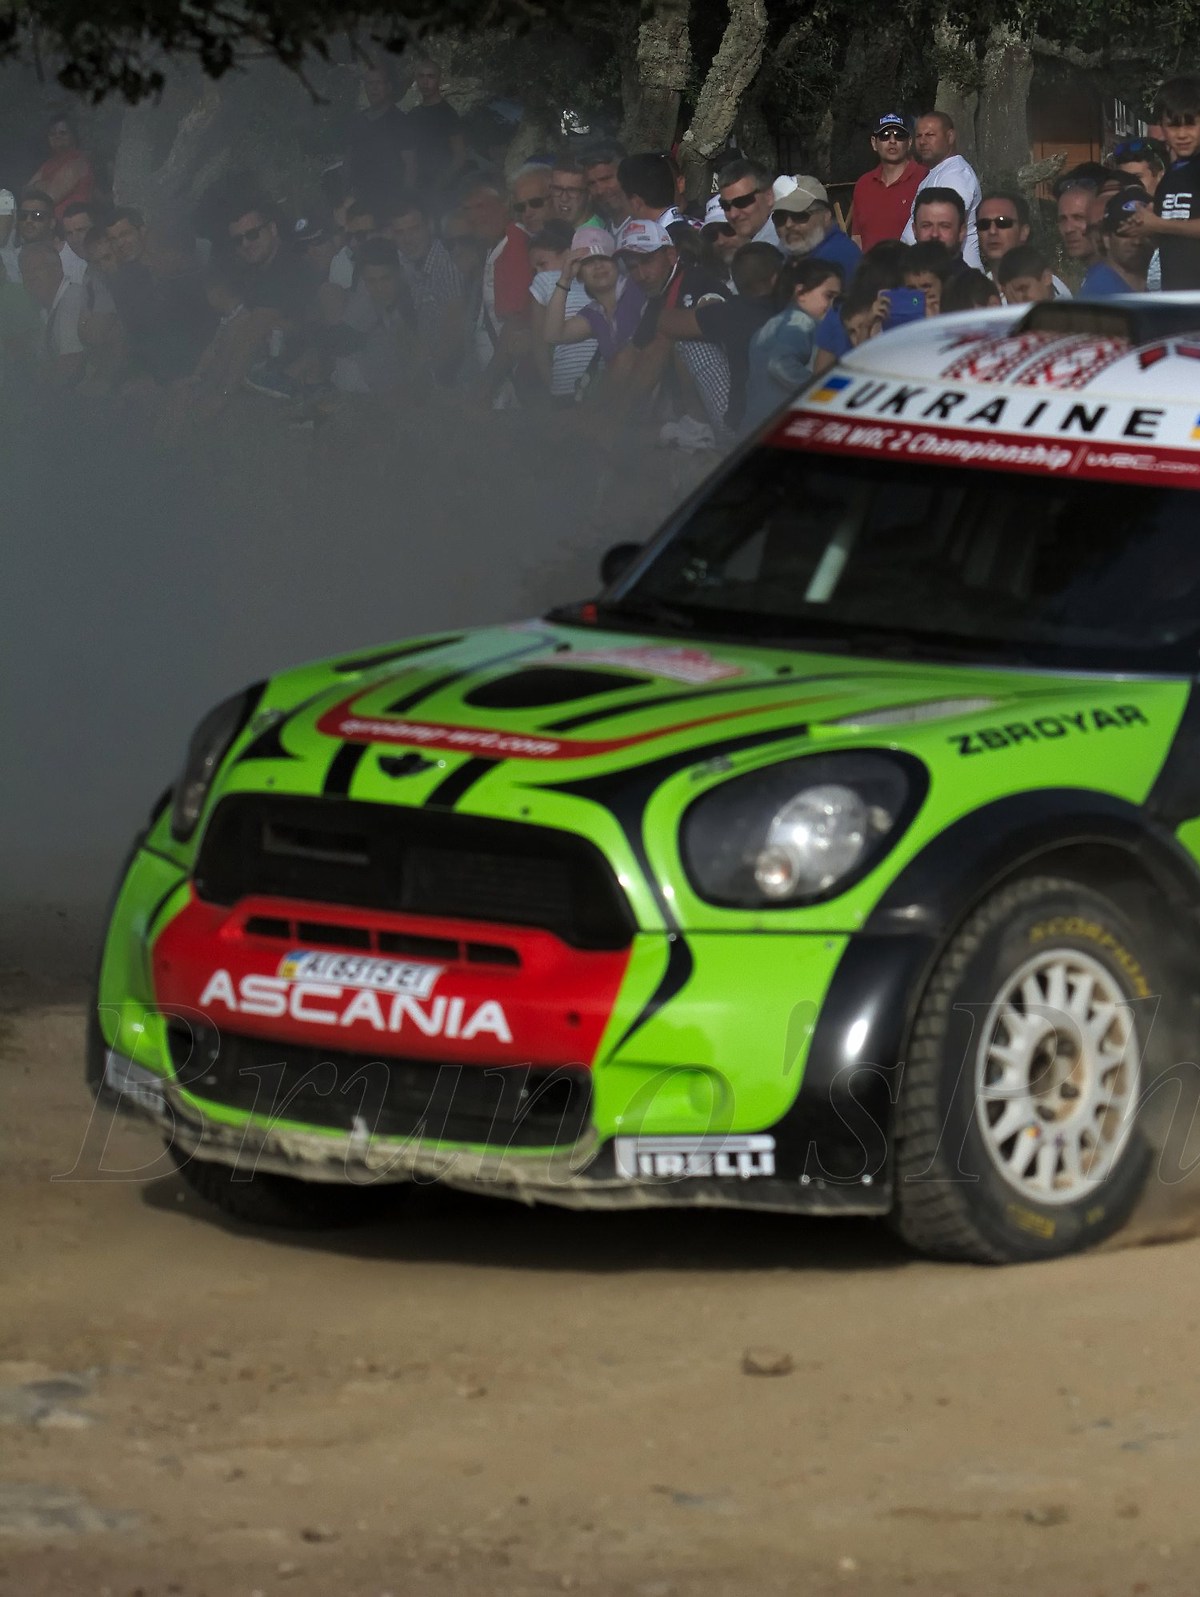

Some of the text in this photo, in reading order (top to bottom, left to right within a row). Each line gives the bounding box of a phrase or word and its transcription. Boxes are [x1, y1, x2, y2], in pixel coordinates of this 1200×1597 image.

[845, 381, 1166, 439] UKRAINE
[847, 425, 895, 449] WRC
[889, 431, 911, 450] 2
[907, 432, 1073, 470] Championship
[947, 704, 1148, 756] ZBROYAR
[199, 968, 514, 1044] ASCANIA
[614, 1134, 777, 1178] PIRELLI
